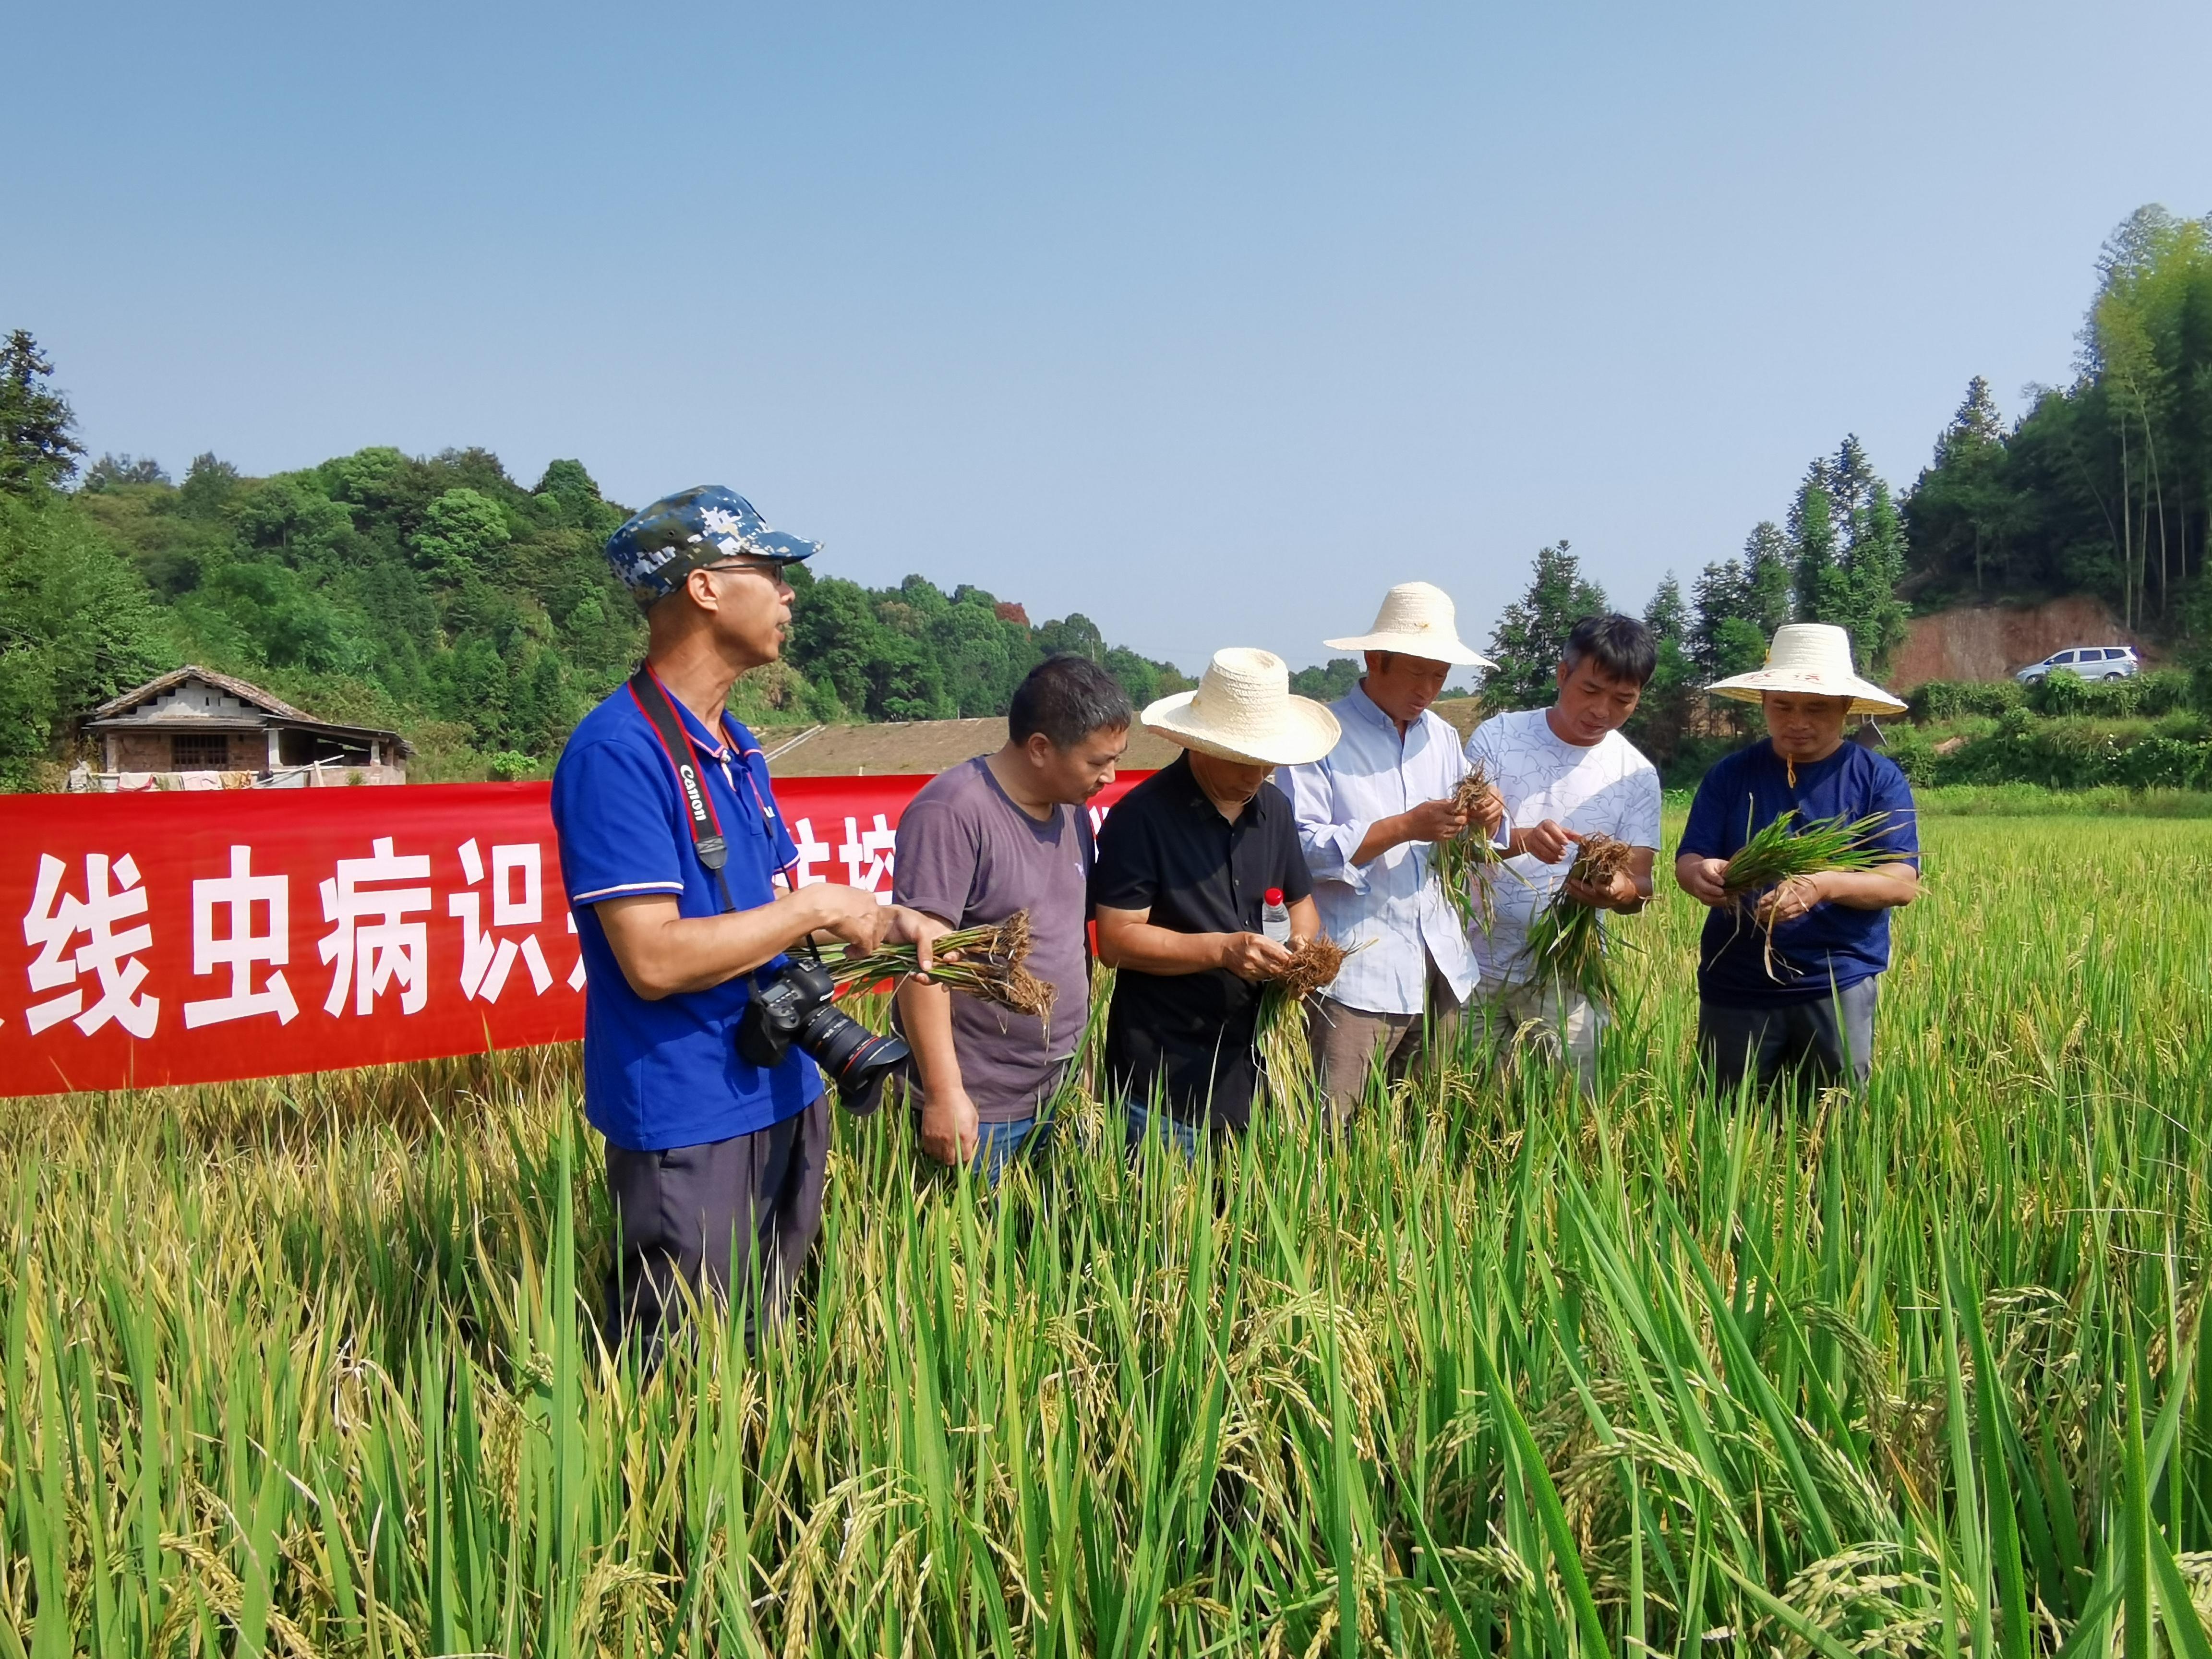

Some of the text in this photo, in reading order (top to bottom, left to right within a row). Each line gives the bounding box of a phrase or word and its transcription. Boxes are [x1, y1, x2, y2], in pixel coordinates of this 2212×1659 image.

[680, 765, 707, 821] Canon
[0, 836, 587, 1038] 线虫病识
